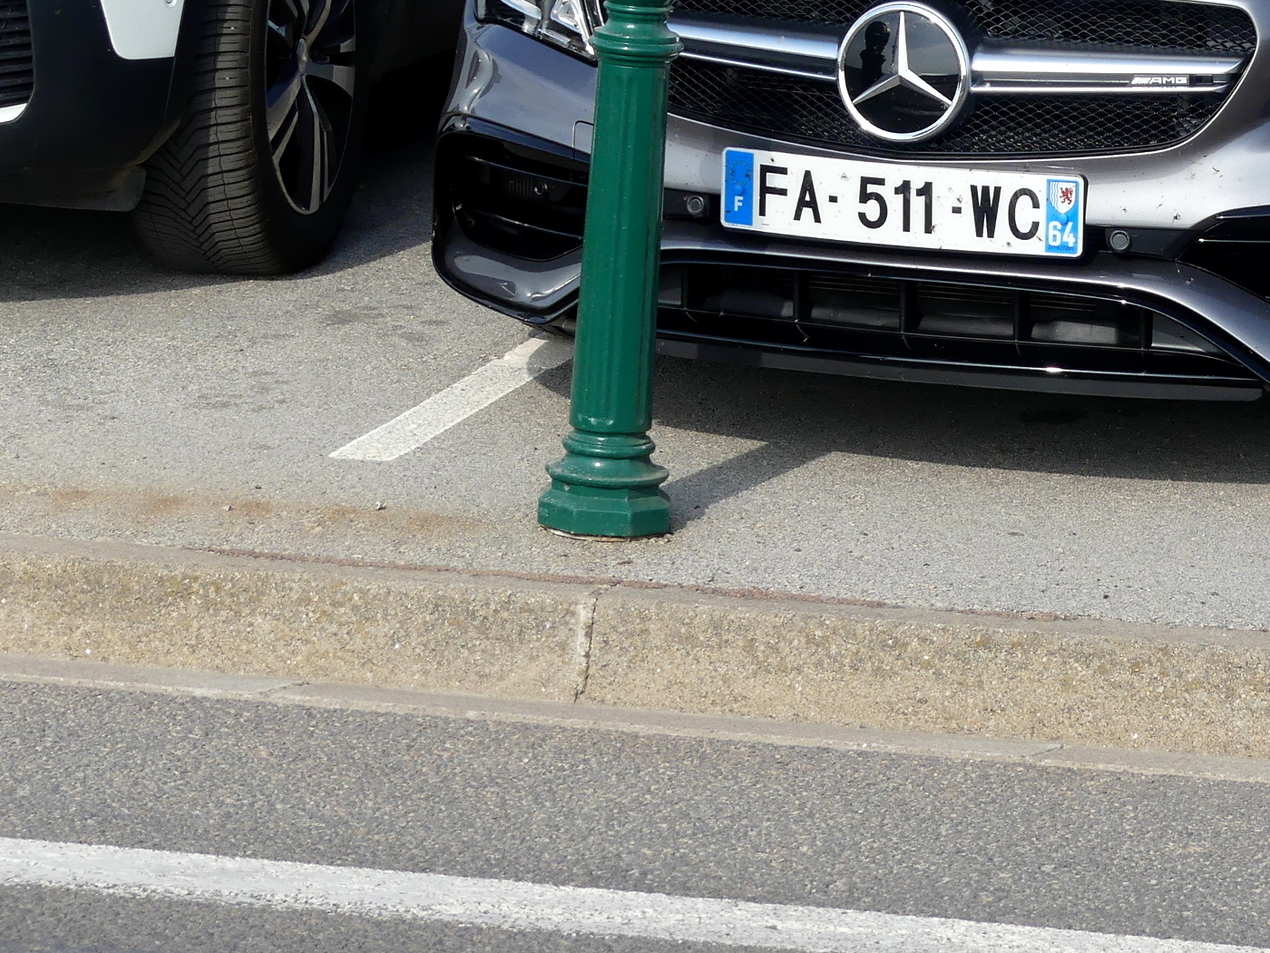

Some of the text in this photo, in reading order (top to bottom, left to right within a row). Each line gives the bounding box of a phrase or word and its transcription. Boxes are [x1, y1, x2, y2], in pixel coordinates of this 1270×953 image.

[1149, 76, 1188, 85] AMG
[734, 195, 744, 212] F
[1048, 220, 1076, 248] 64
